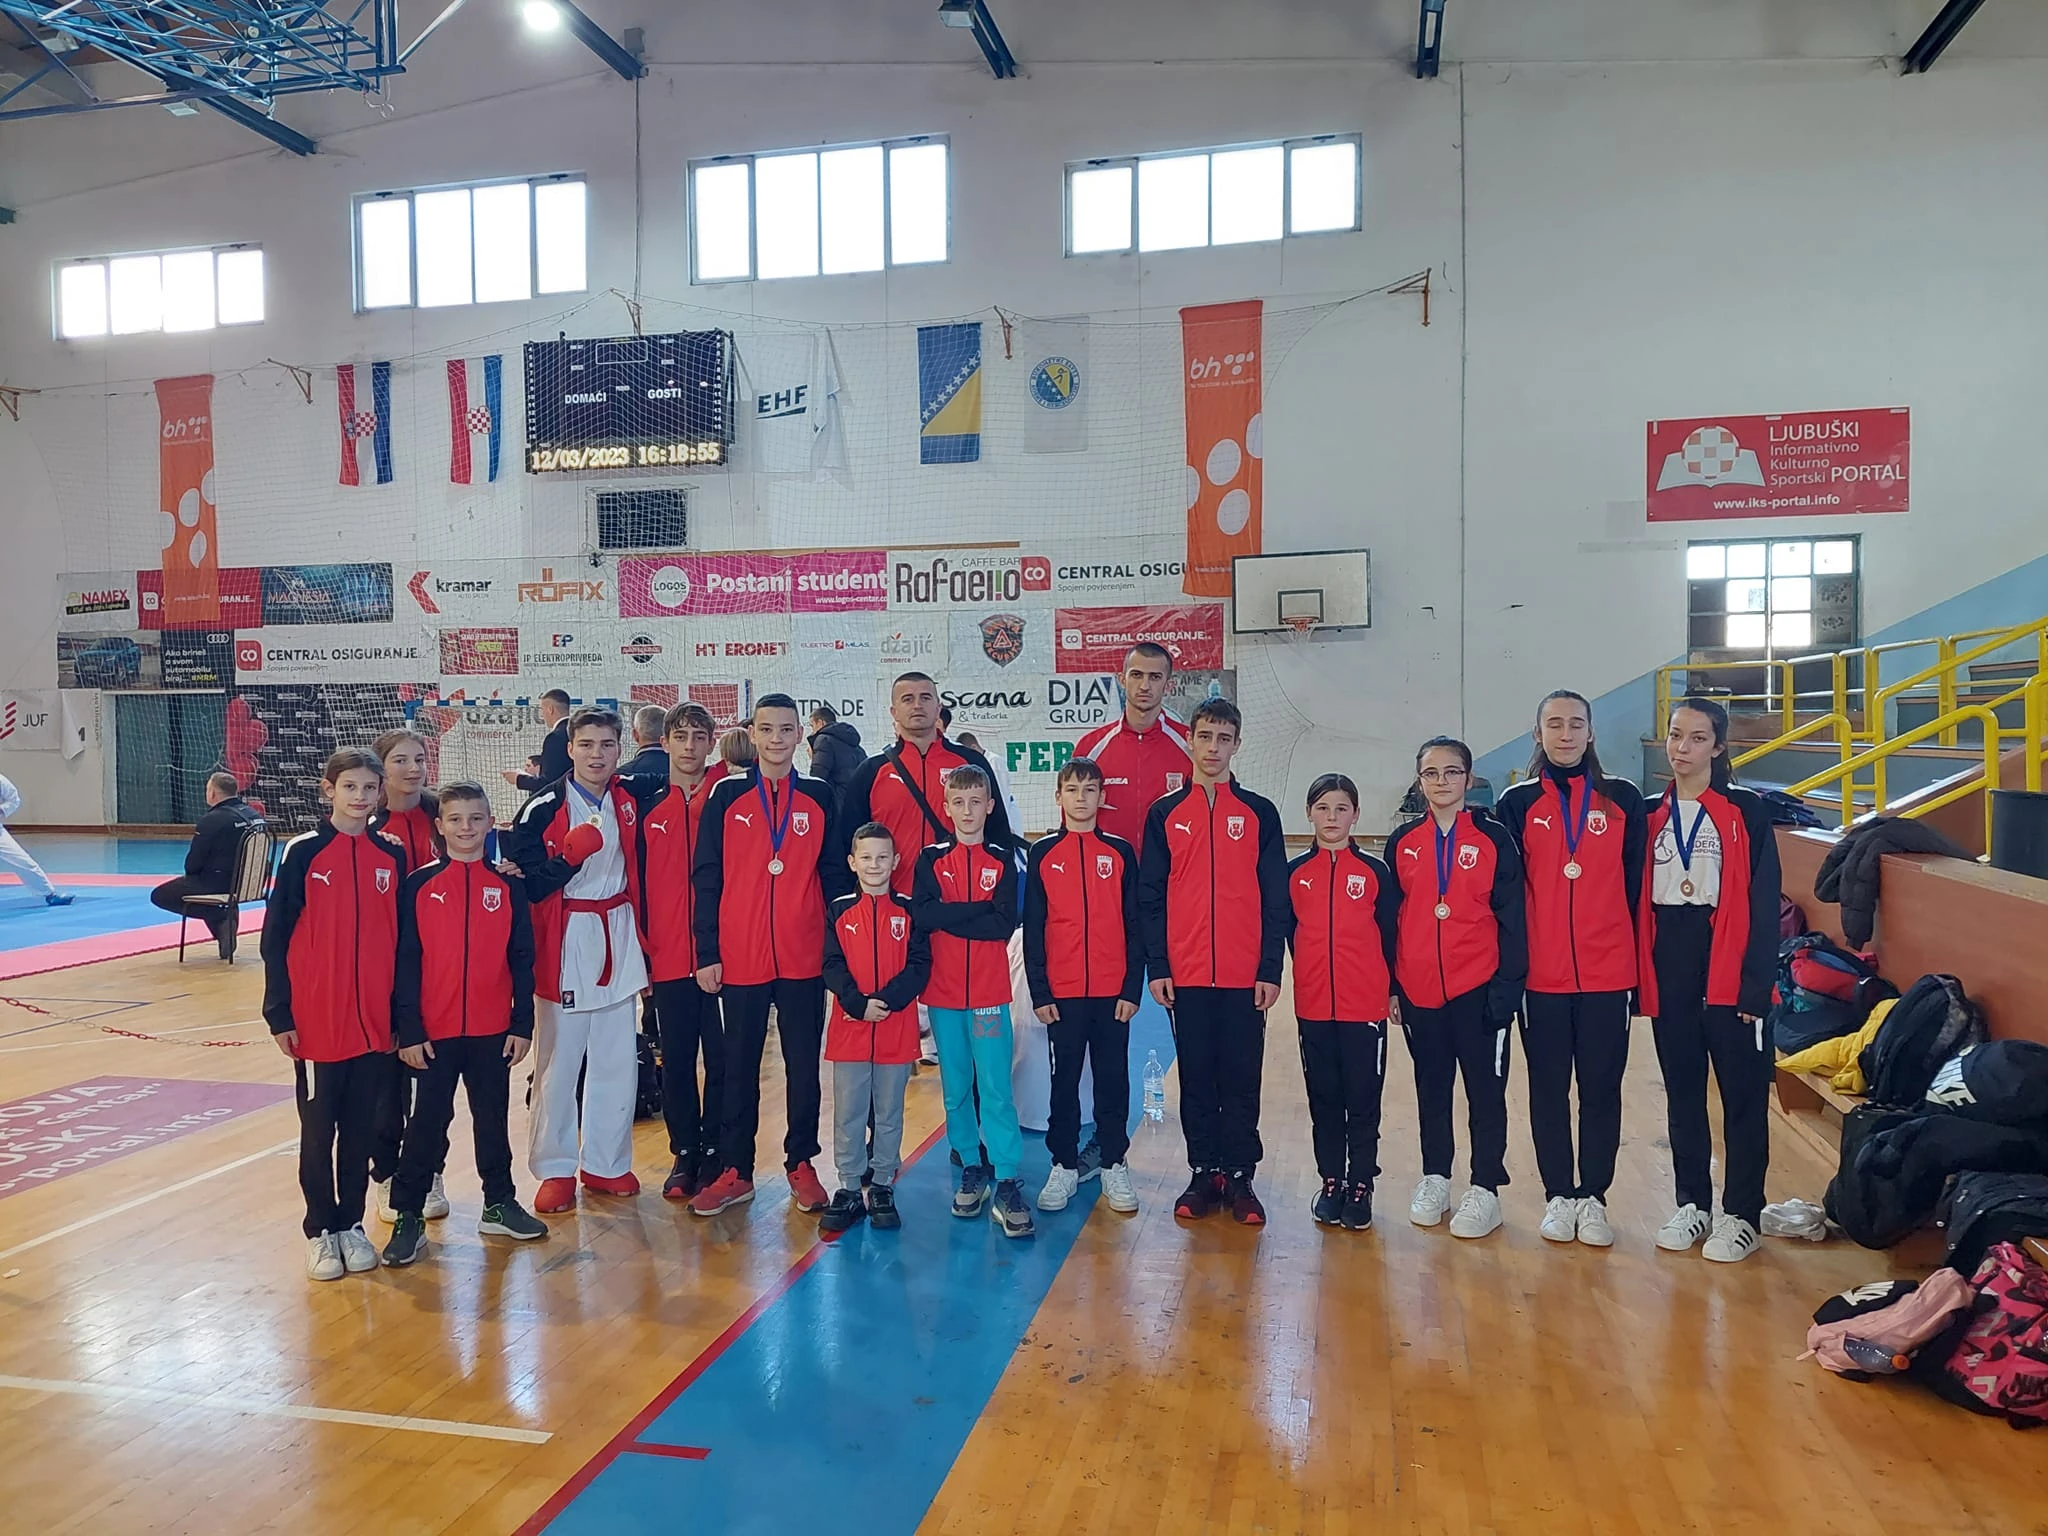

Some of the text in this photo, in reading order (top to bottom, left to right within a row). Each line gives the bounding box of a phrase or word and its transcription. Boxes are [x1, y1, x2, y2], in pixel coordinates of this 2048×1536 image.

[564, 388, 682, 404] DOMAĆI GOSTI
[757, 384, 809, 414] EHF
[1769, 420, 1859, 442] LJUBUŠKI
[531, 443, 721, 470] 12/03/2023 16:18:55
[1770, 442, 1860, 456] Informativno
[1770, 457, 1830, 470] Kulturno
[1770, 465, 1906, 487] Sportski PORTAL
[1713, 494, 1840, 510] www.iks-portal.info
[962, 557, 1021, 567] CAFFE BAR
[1058, 565, 1135, 580] CENTRAL
[436, 578, 492, 592] kramar
[654, 582, 687, 591] LOGOS
[706, 569, 889, 593] Postani student
[1058, 583, 1135, 592] Spojeni povjerenjem
[81, 589, 128, 604] NAMEX
[219, 594, 250, 603] URANJE
[1086, 633, 1134, 643] CENTRAL
[1136, 631, 1205, 641] OSIGURANJE
[267, 649, 328, 661] CENTRAL
[332, 648, 418, 660] OSIGURANJE
[940, 690, 1032, 709] scana
[1050, 708, 1106, 723] GRUP
